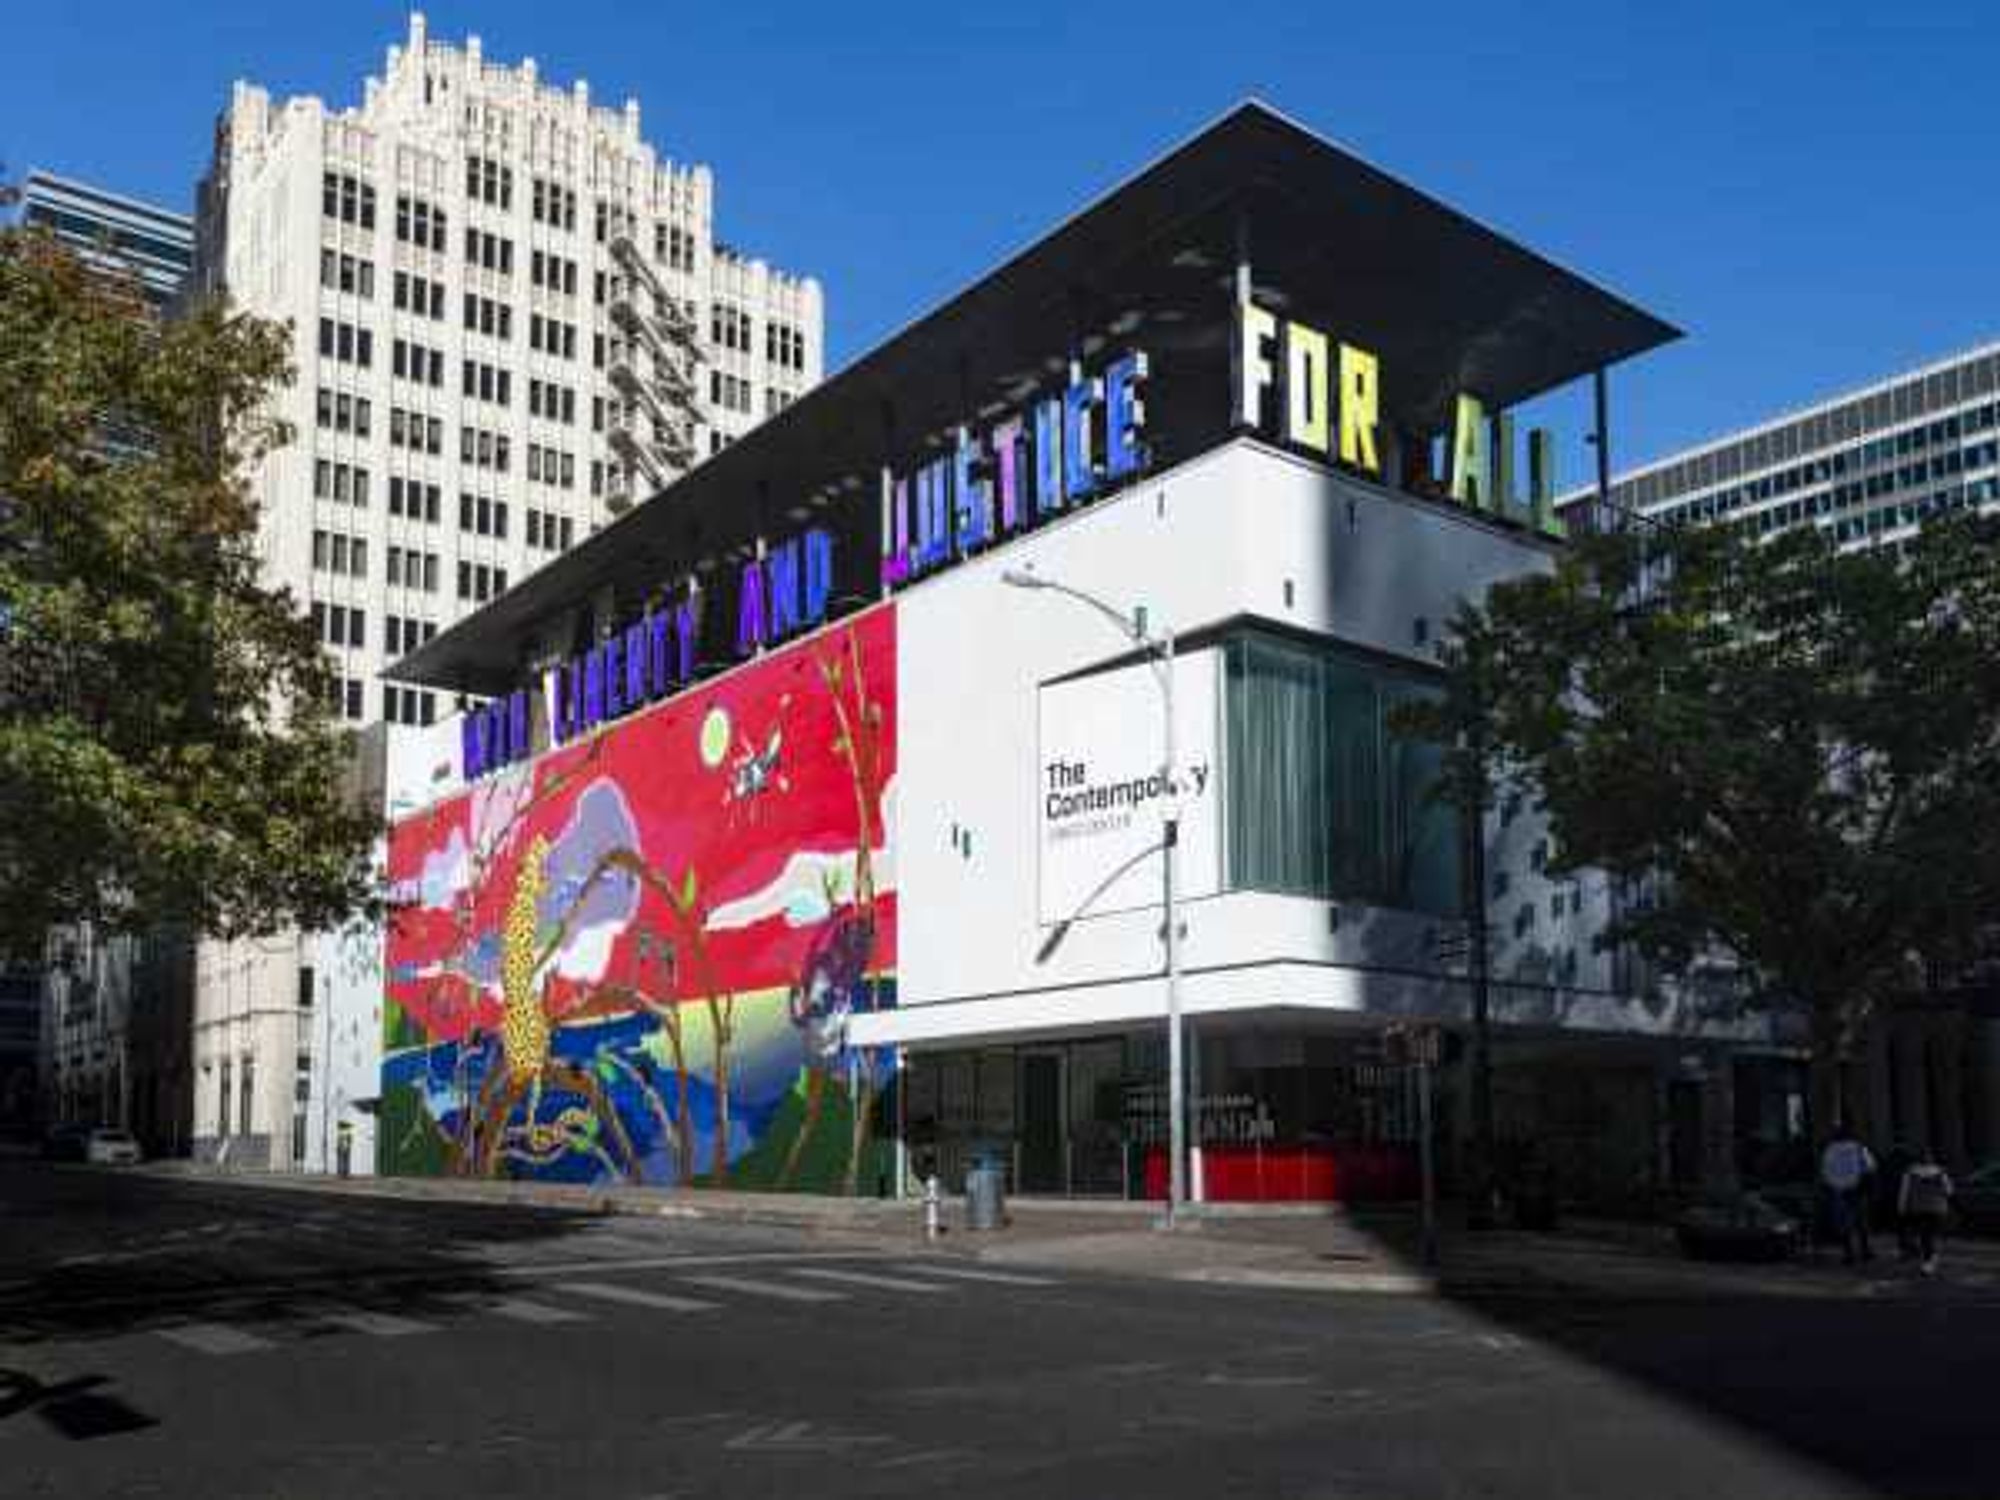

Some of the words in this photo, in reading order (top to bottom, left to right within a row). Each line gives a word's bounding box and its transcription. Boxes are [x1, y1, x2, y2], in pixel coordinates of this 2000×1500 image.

[1242, 302, 1381, 473] FOR
[1453, 393, 1569, 538] ALL
[549, 592, 697, 748] LIBERTY
[738, 530, 831, 647] AND
[881, 350, 1152, 585] JUSTICE
[1046, 759, 1085, 789] The
[1047, 760, 1208, 820] Contempoy
